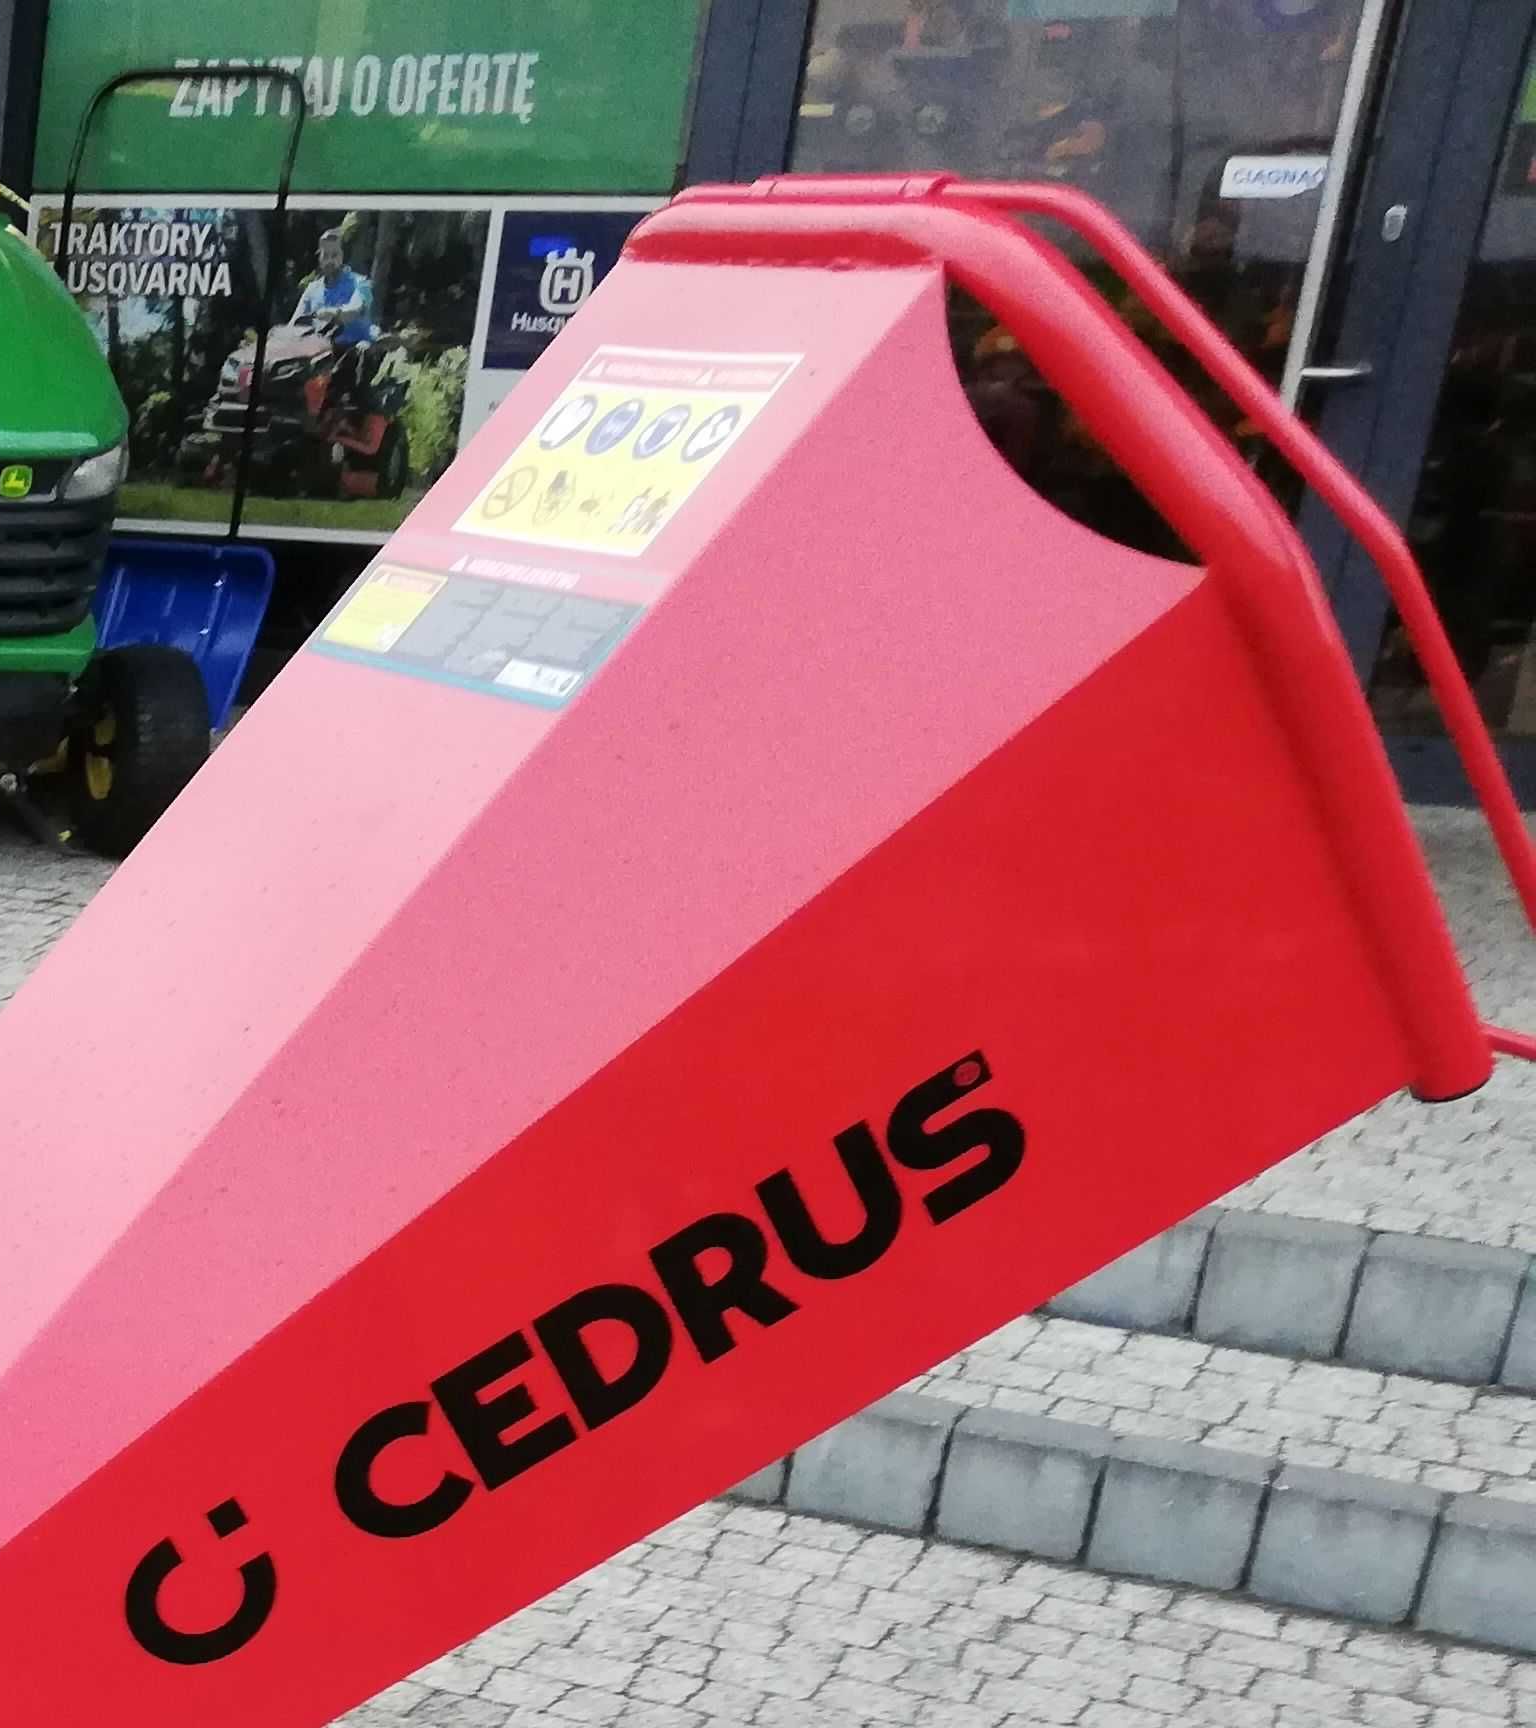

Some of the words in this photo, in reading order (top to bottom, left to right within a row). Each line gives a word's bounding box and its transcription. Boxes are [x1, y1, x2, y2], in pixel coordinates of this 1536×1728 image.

[169, 55, 344, 118] ZAPYTAJ
[350, 54, 382, 117] O
[387, 52, 540, 124] OFERTĘ
[47, 260, 232, 297] USQVARNA
[334, 1050, 1026, 1539] CEDRUS
